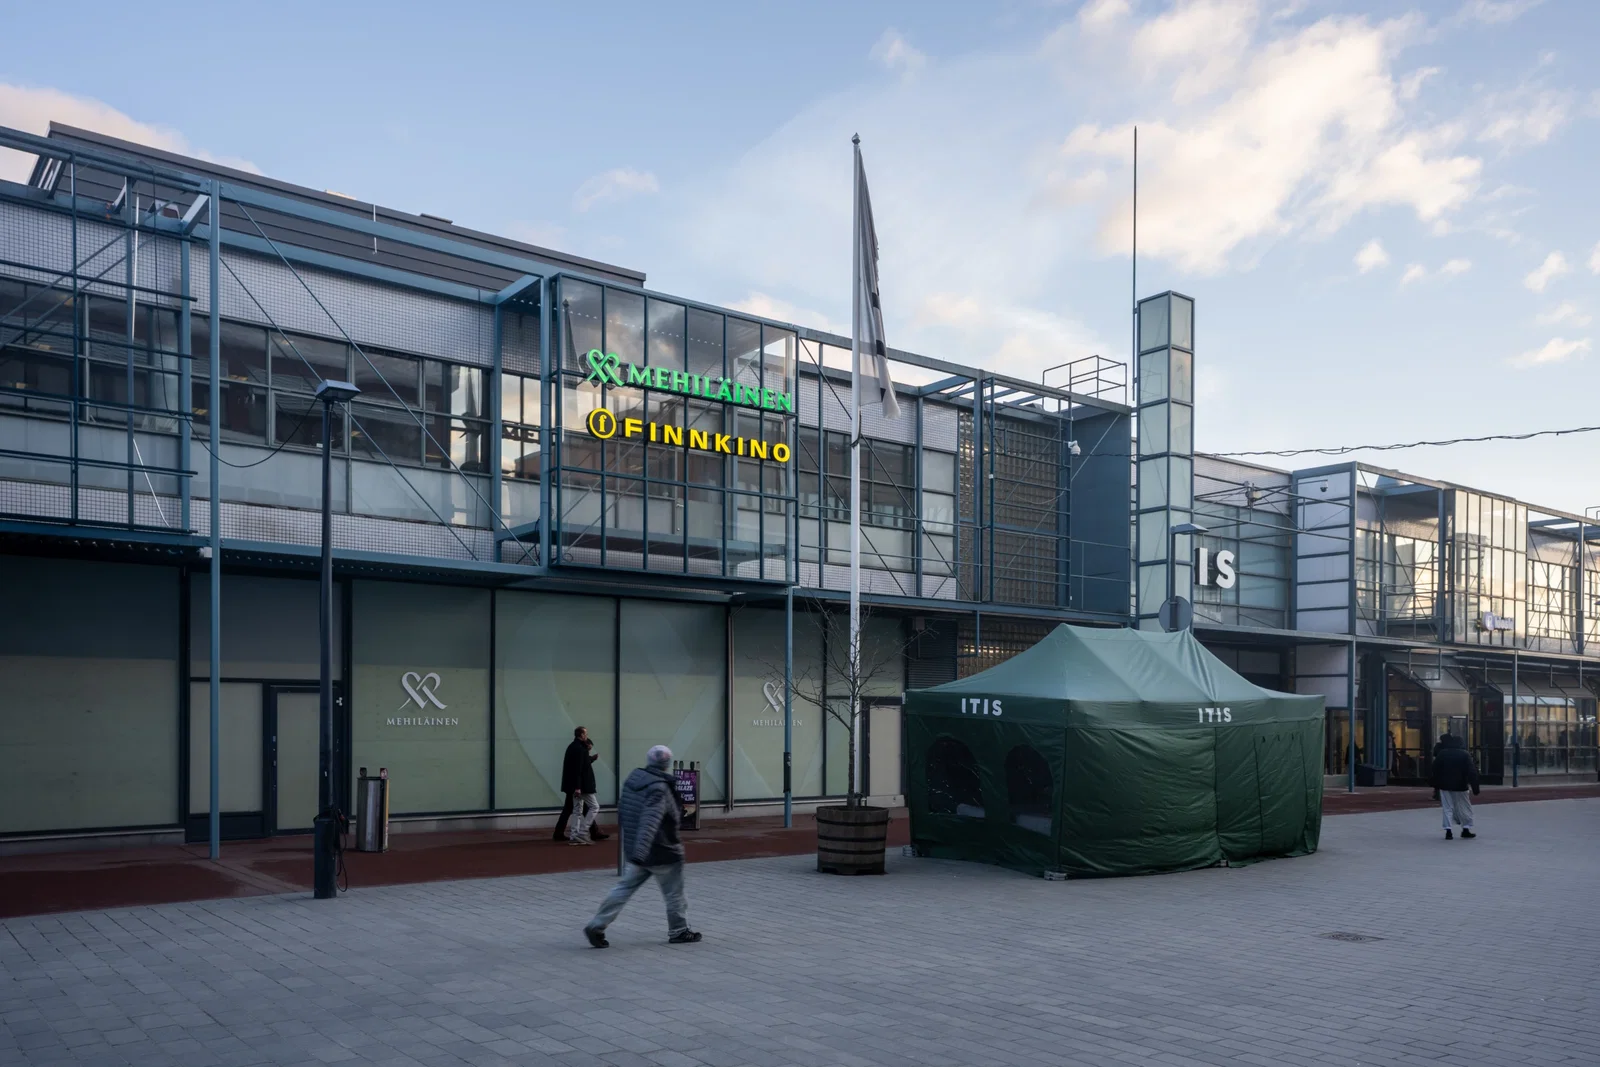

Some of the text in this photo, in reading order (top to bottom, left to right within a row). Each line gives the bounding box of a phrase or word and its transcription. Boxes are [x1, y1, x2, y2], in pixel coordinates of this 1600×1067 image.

[628, 362, 792, 412] MEHILÄINEN
[624, 417, 791, 463] FINNKINO
[961, 698, 1003, 717] ITIS
[1198, 707, 1232, 723] ITIS
[386, 716, 459, 726] MEHILÄINEN
